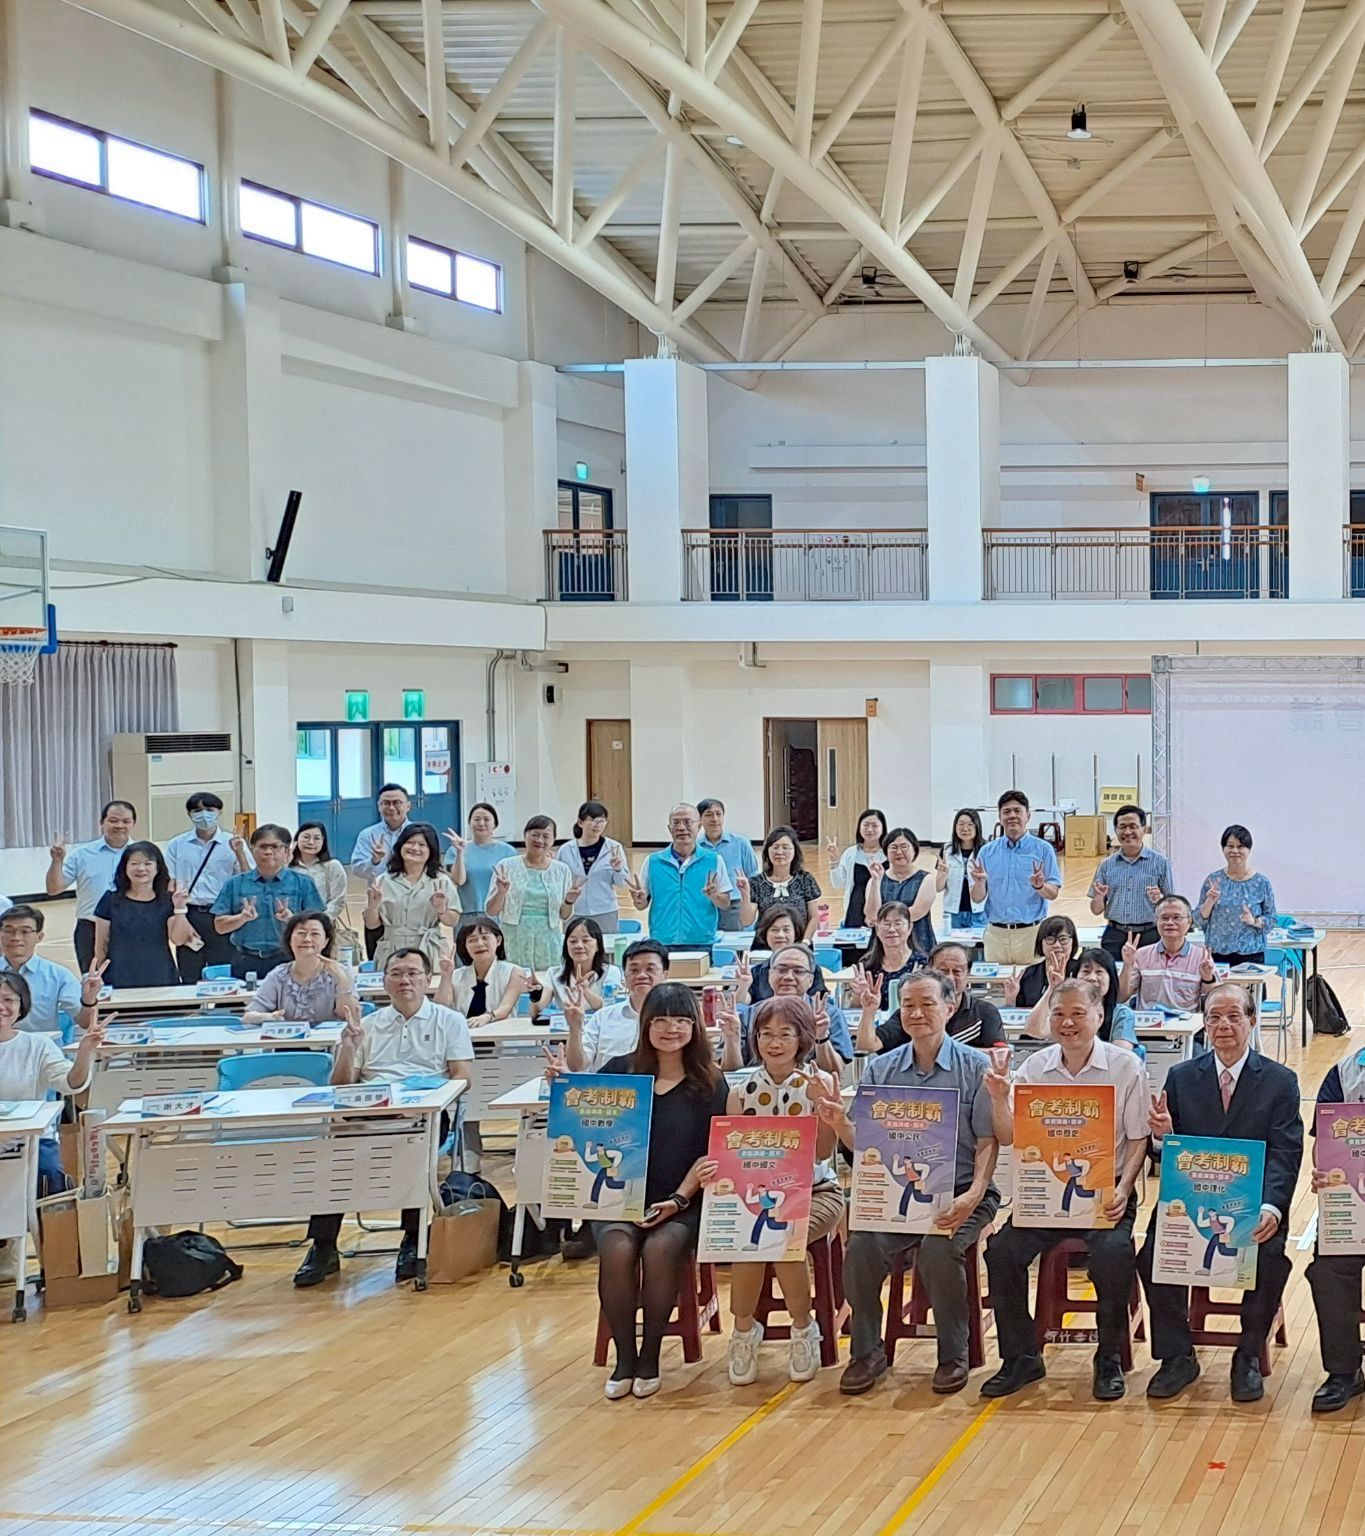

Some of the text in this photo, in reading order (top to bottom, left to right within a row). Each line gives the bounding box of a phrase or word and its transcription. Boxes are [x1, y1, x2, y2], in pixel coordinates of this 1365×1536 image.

[565, 1087, 637, 1109] 會考制霸
[1028, 1098, 1100, 1118] 會考制霸
[871, 1100, 943, 1123] 會考制霸
[726, 1130, 800, 1149] 會考制霸
[743, 1161, 777, 1169] 國中國文
[1177, 1150, 1249, 1175] 會考制霸
[1193, 1183, 1226, 1192] 國中理化
